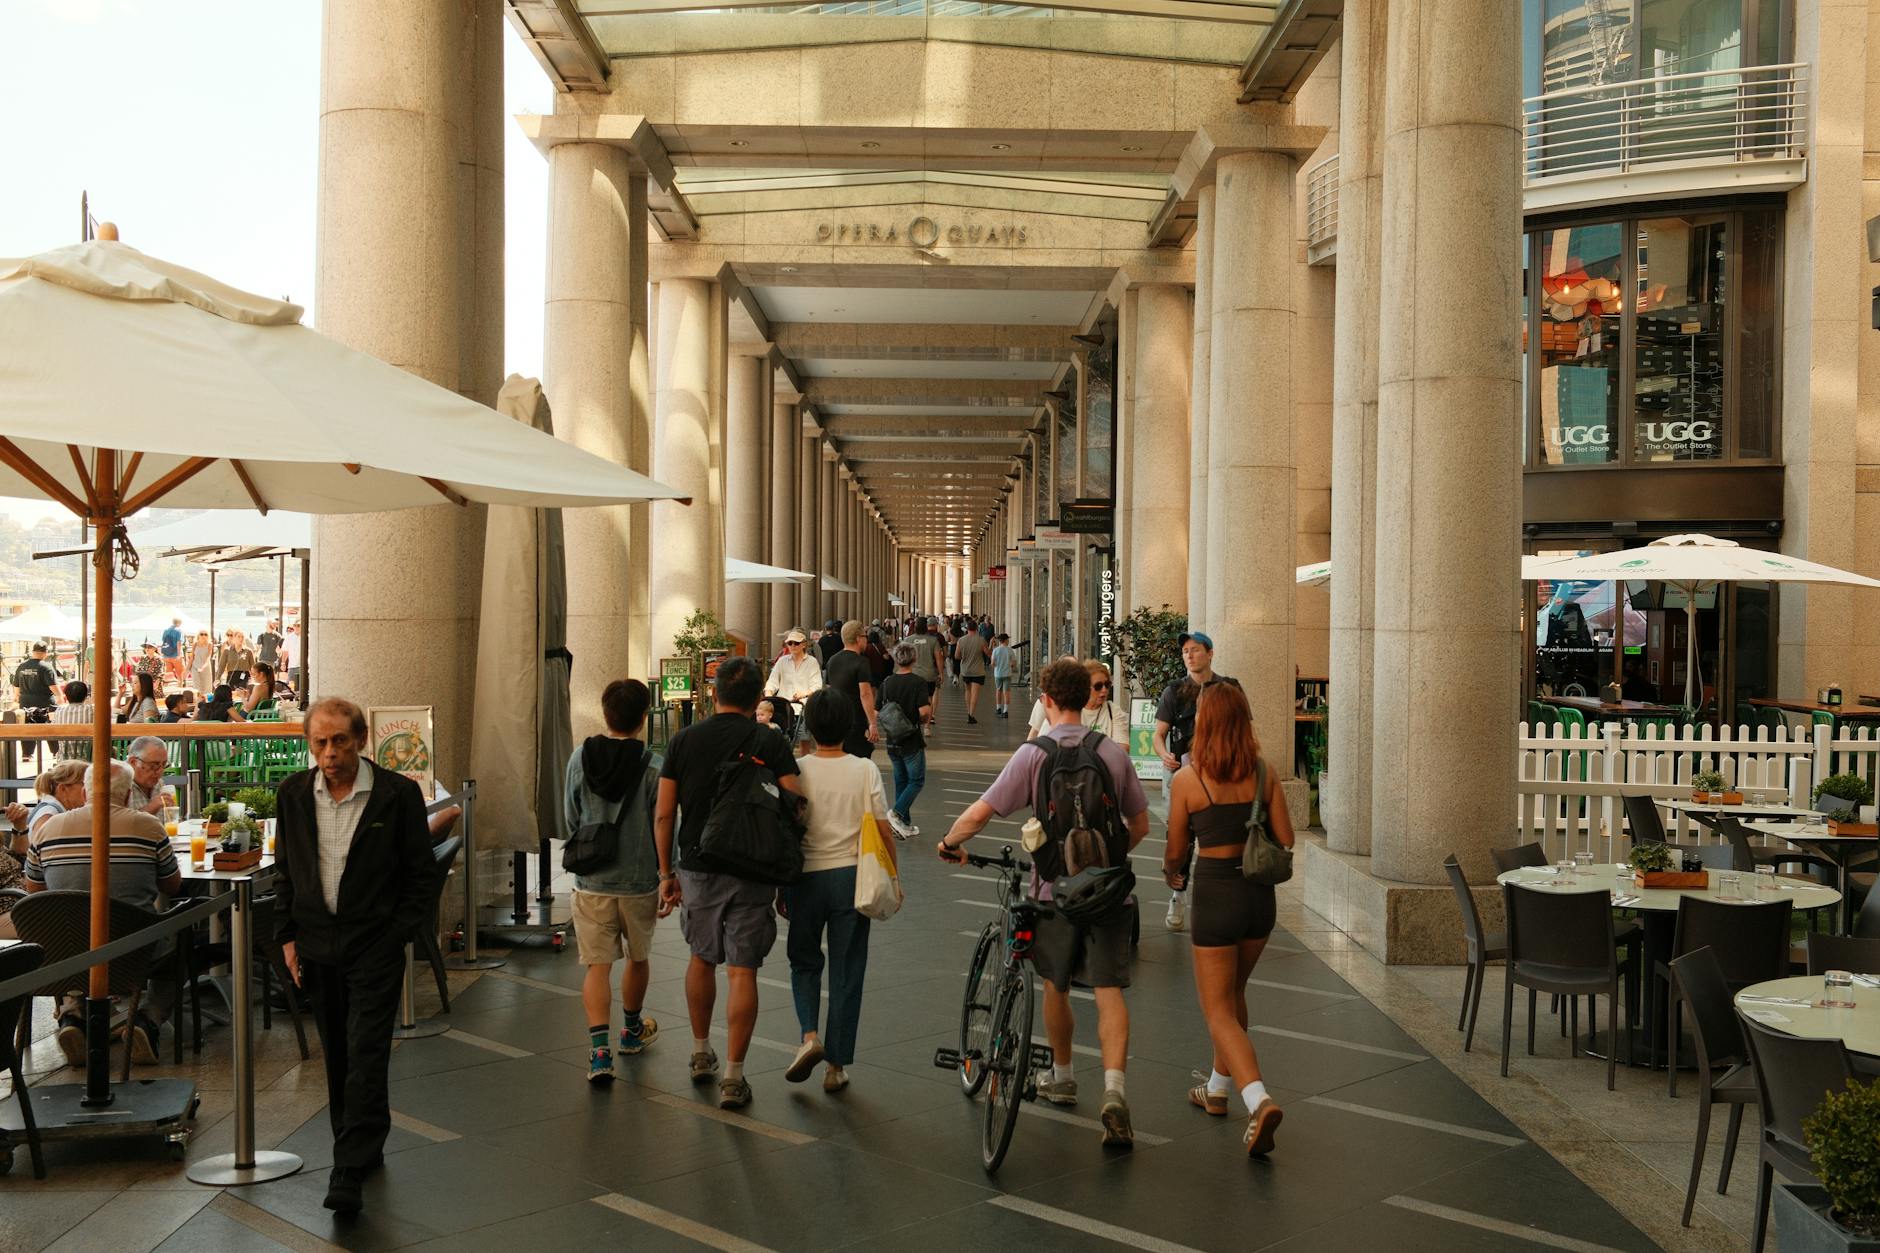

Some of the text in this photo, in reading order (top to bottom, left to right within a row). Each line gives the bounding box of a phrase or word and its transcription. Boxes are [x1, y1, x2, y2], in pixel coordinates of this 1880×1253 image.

[816, 223, 898, 242] OPERA
[947, 223, 1028, 243] QUAYS
[1550, 424, 1610, 446] UGG
[1646, 420, 1712, 442] UGG
[1662, 442, 1688, 450] Outlet
[666, 667, 688, 675] LUNCH
[667, 676, 685, 690] $25
[376, 719, 420, 739] LUNCH
